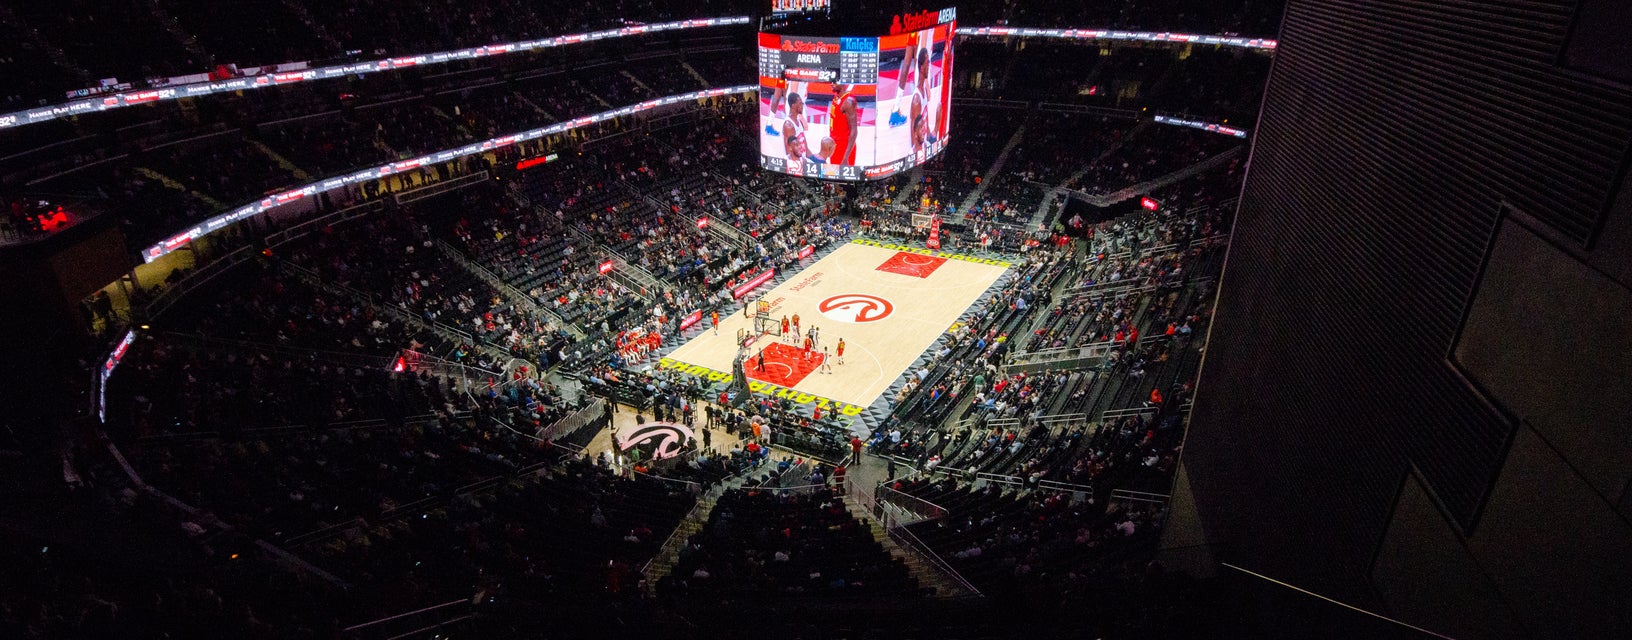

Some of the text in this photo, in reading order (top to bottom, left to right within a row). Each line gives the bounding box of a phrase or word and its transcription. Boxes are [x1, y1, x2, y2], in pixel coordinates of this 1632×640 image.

[938, 7, 956, 24] ARENA
[846, 38, 874, 51] Knicks
[797, 54, 821, 64] ARENA
[770, 157, 785, 166] 4:15
[806, 163, 818, 173] 14
[843, 166, 856, 177] 21
